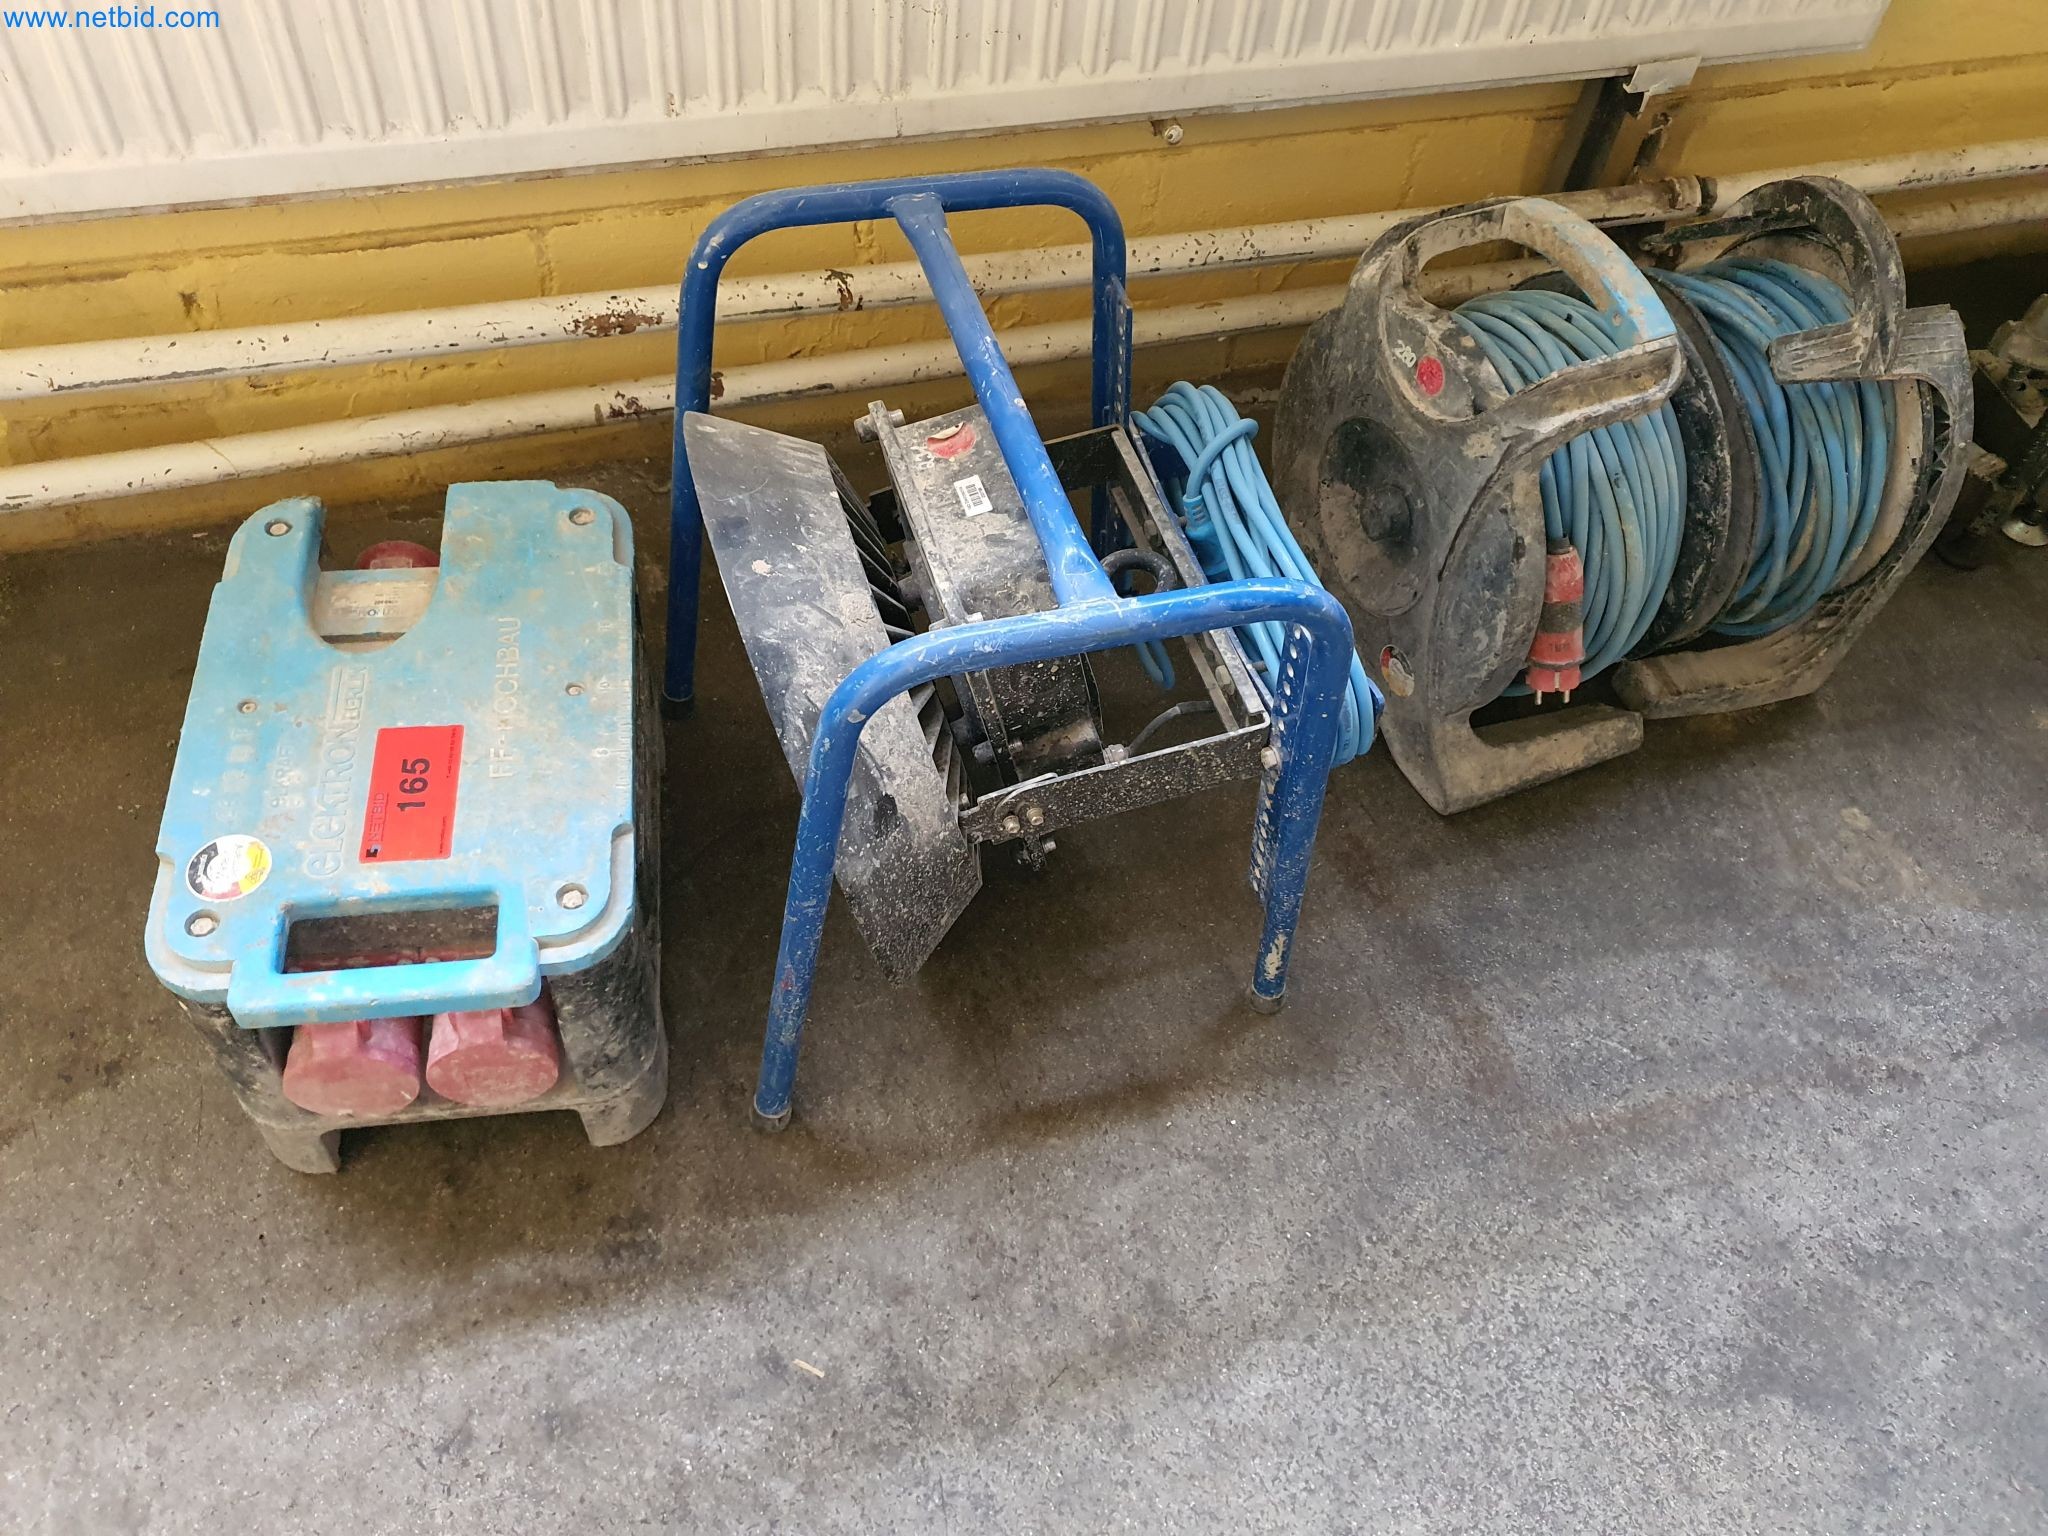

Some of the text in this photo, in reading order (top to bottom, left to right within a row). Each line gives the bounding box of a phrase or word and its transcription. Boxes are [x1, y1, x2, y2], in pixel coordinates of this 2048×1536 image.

[1391, 339, 1417, 368] 280
[396, 758, 431, 812] 165
[367, 792, 386, 842] NETBID
